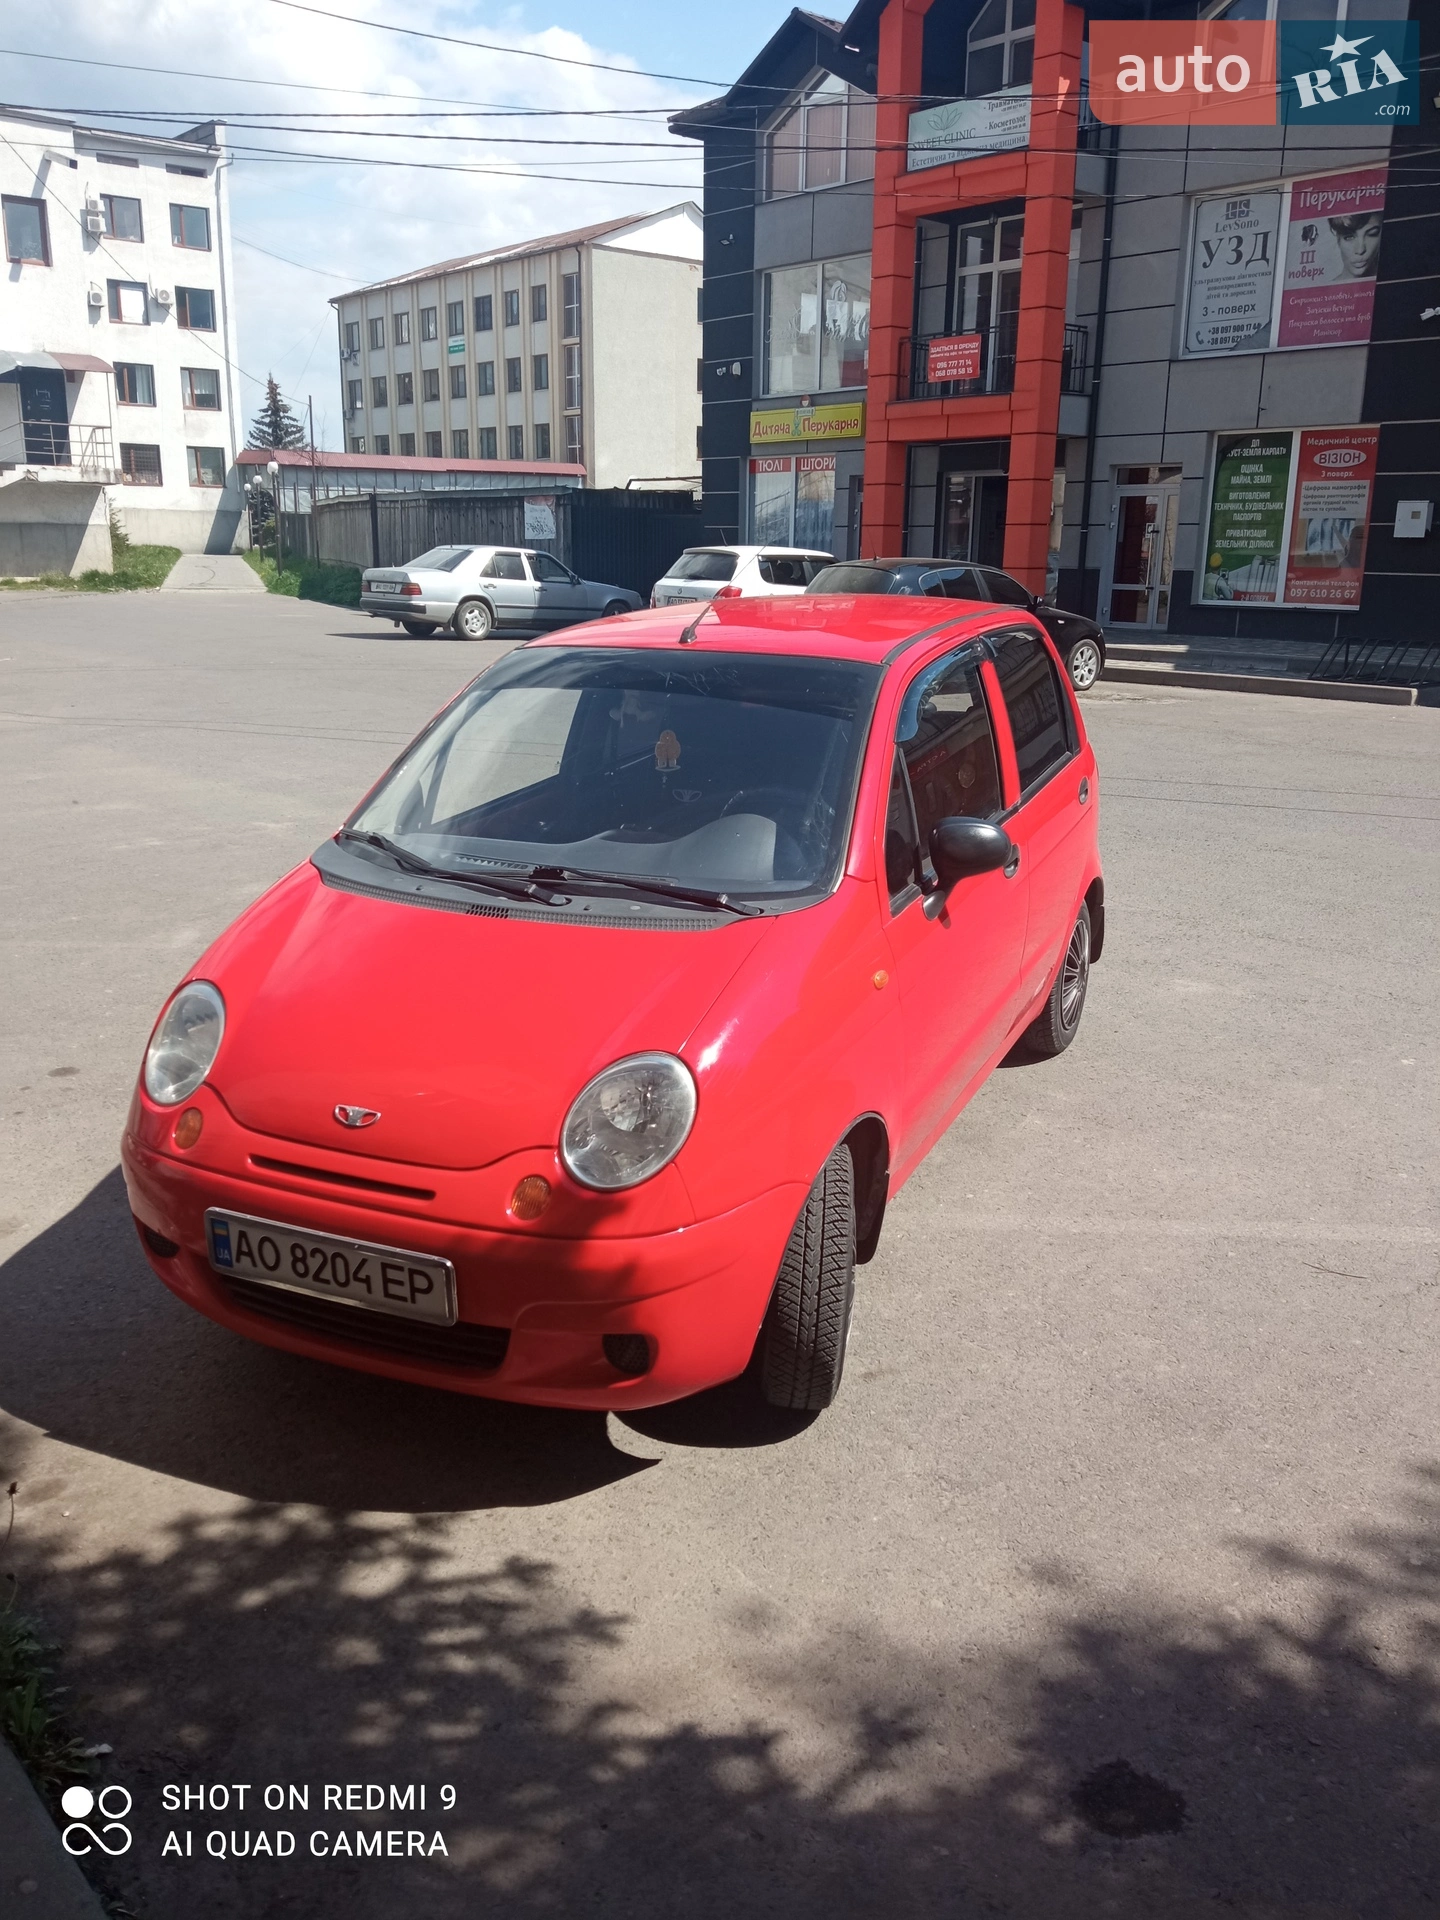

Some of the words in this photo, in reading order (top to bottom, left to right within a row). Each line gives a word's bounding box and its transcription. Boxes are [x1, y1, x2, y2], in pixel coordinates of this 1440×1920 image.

[988, 115, 1026, 130] Косметолог
[945, 128, 976, 145] CLINIC
[912, 153, 946, 167] Естетична
[989, 135, 1026, 149] медицина
[1300, 183, 1385, 211] Перукарня
[1215, 219, 1259, 233] LevSono
[1200, 230, 1272, 271] УЗД
[1288, 266, 1324, 280] поверх
[1202, 306, 1208, 317] 3
[1218, 303, 1256, 315] поверх
[1208, 326, 1219, 335] +38
[1221, 325, 1231, 334] 097
[753, 421, 790, 438] Дитяча
[802, 417, 859, 435] Перукарня
[1250, 439, 1260, 448] ДП
[1307, 436, 1349, 445] Медичний
[1352, 436, 1377, 445] центр
[1227, 448, 1261, 457] УСТ-ЗЕМЛЯ
[1319, 452, 1361, 464] ВІЗІОН
[759, 459, 783, 472] ТЮЛІ
[800, 457, 836, 470] ШТОРИ
[1241, 464, 1263, 473] ОЦІНКА
[1229, 491, 1270, 500] ВИГОТОВЛЕННЯ
[1245, 502, 1284, 511] БУДІВЕЛЬНИХ
[1226, 529, 1267, 537] ПРИВАТИЗАЦІЯ
[1215, 540, 1248, 548] ЗЕМЕЛЬНИХ
[1249, 540, 1274, 549] ДІЛЯНОК
[1331, 580, 1359, 588] телефон
[1290, 588, 1308, 597] 097
[1310, 589, 1327, 597] 610
[1330, 589, 1341, 598] 26
[1344, 590, 1356, 598] 67
[216, 1248, 231, 1261] UA
[235, 1229, 281, 1271] AO
[290, 1242, 372, 1295] 8204
[380, 1261, 434, 1304] EP
